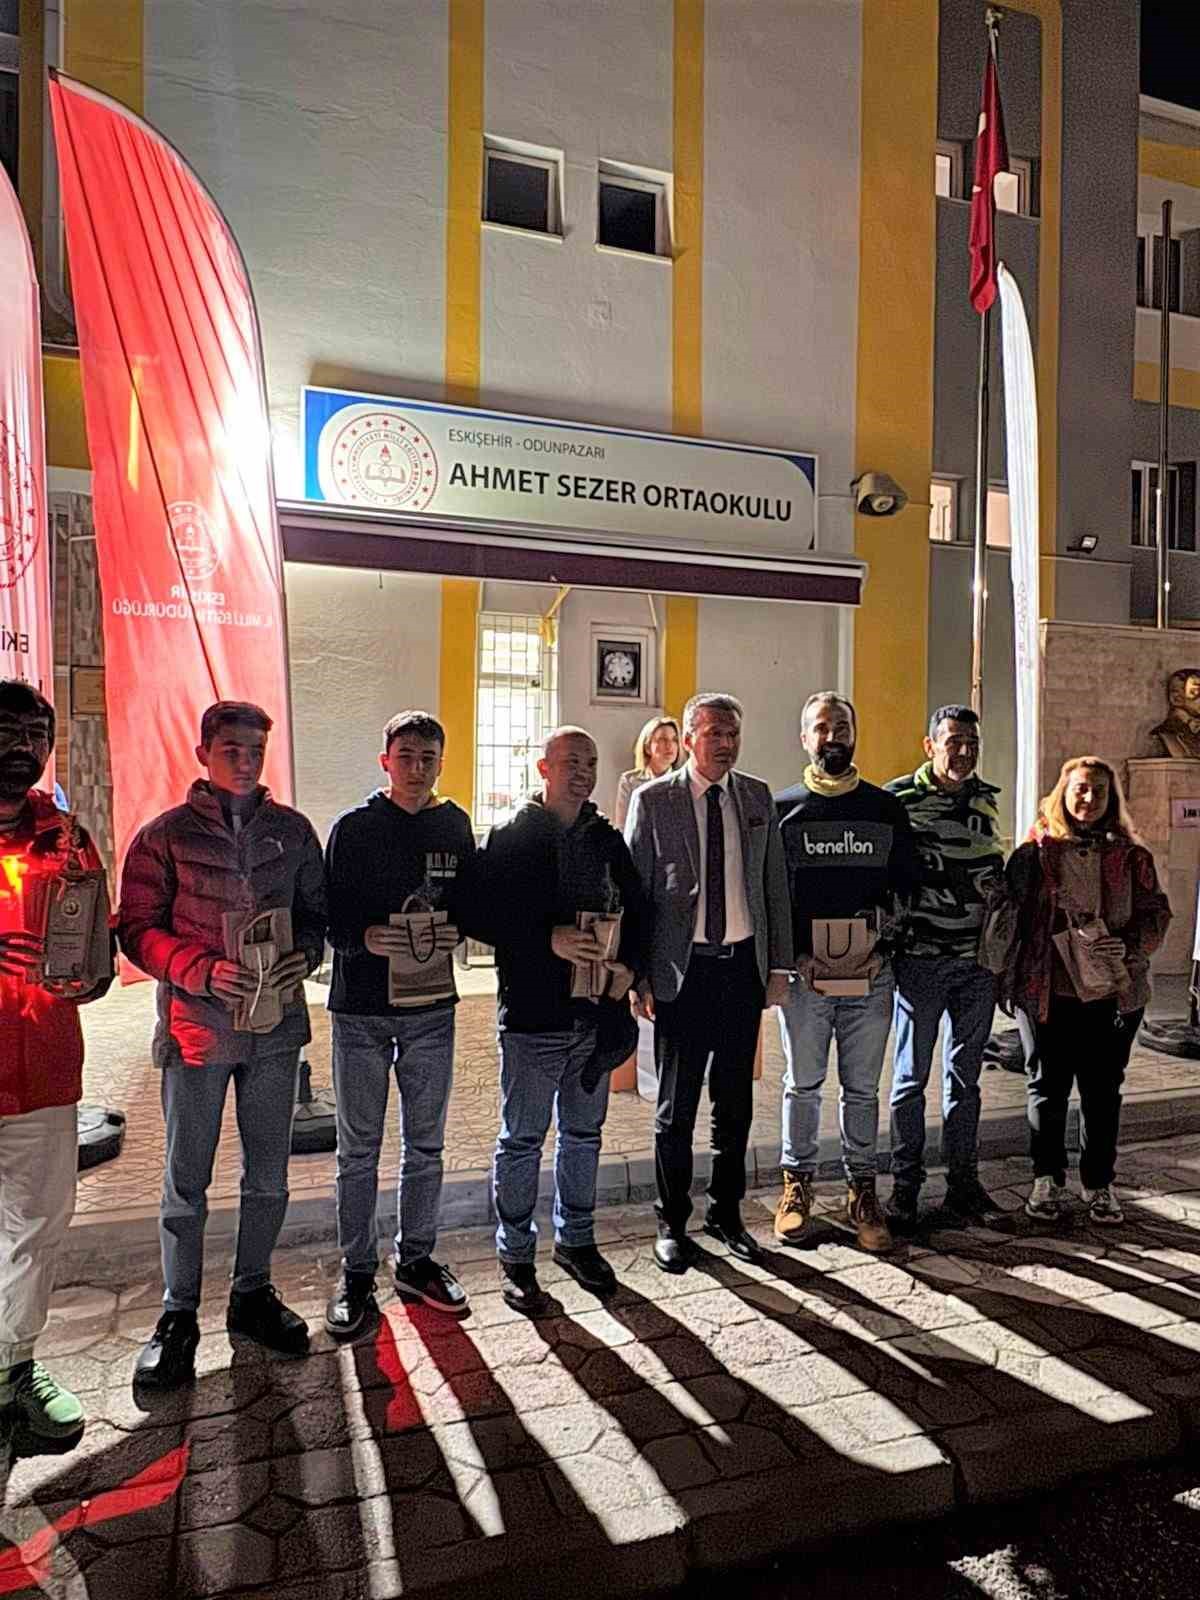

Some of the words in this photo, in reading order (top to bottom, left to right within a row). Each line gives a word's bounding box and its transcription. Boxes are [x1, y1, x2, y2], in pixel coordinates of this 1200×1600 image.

[448, 428, 513, 448] ESKİŞEHİR
[522, 437, 606, 459] ODUNPAZARI
[449, 462, 549, 494] AHMET
[557, 474, 636, 504] SEZER
[643, 484, 792, 521] ORTAOKULU
[803, 830, 873, 855] benetton
